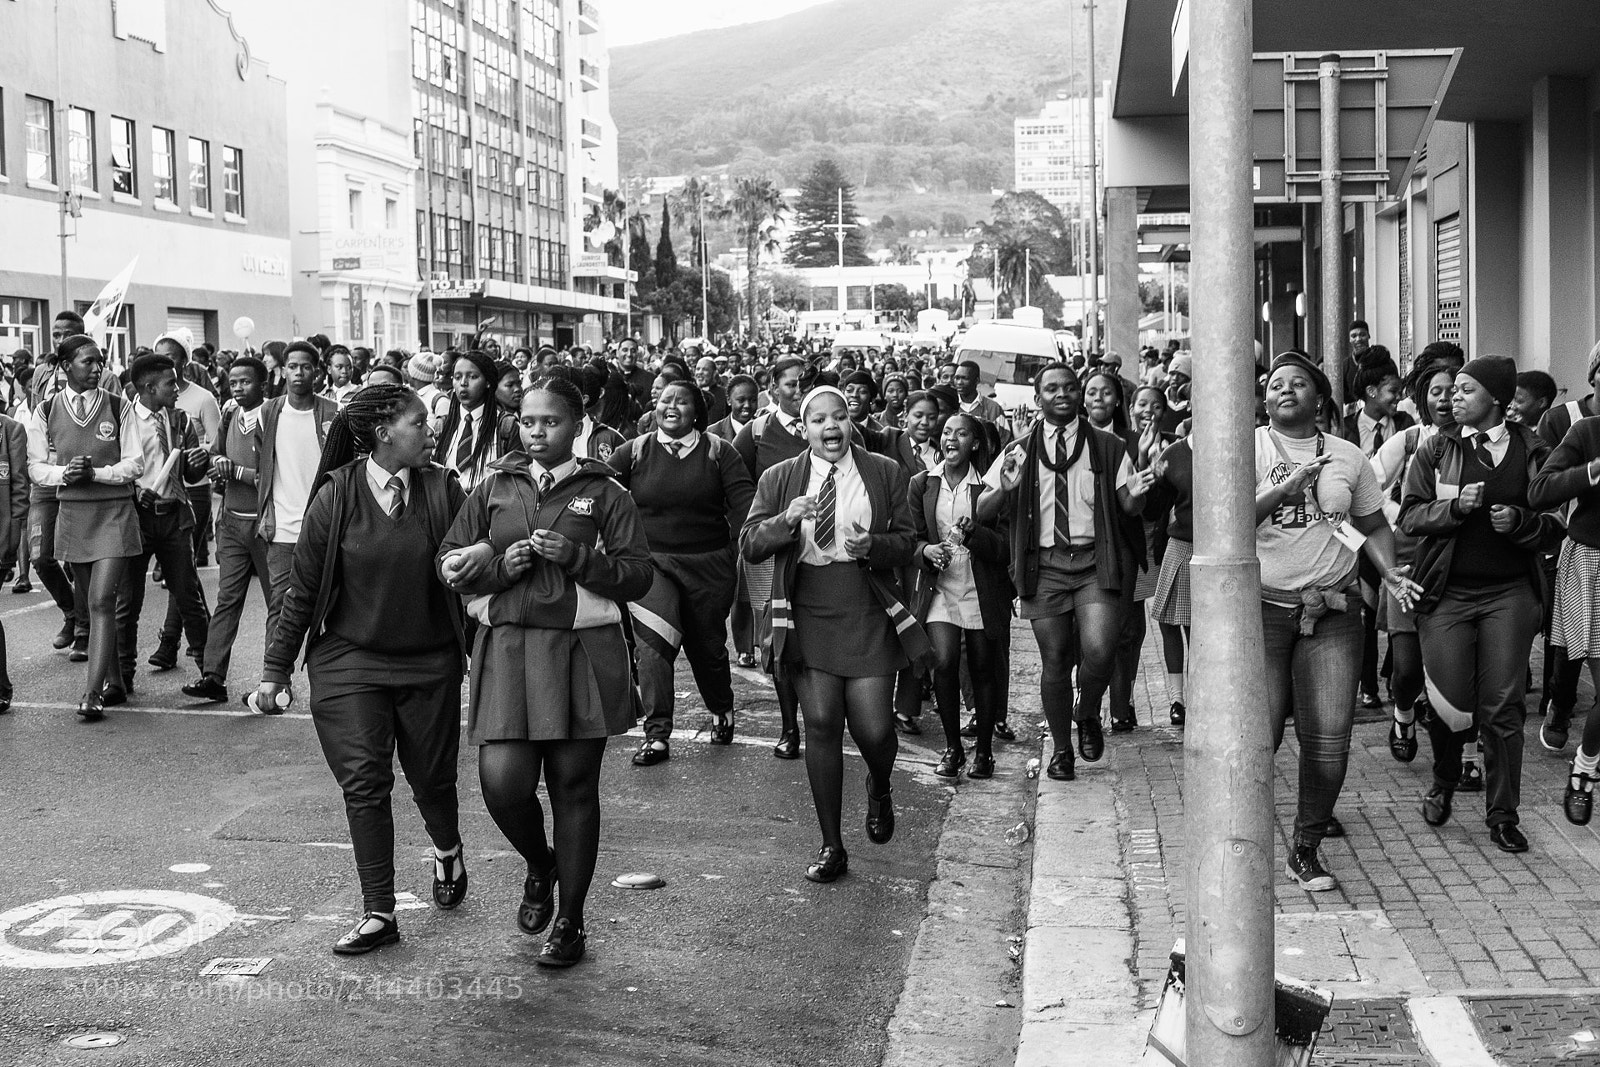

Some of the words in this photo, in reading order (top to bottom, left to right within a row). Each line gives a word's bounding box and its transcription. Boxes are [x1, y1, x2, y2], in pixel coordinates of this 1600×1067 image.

[335, 233, 404, 249] CARPENTER'S
[430, 279, 451, 290] TO
[454, 278, 485, 290] LET
